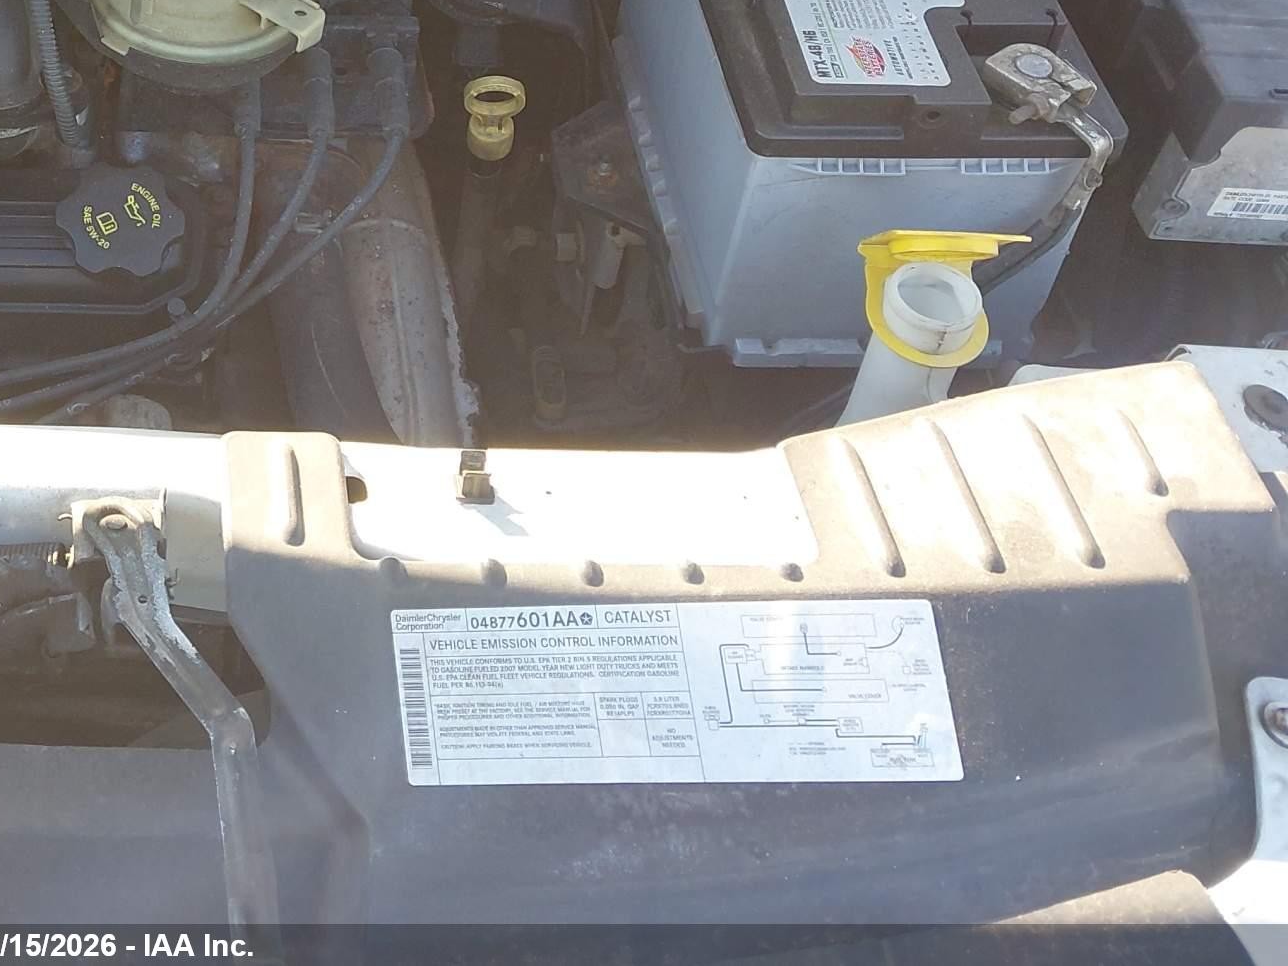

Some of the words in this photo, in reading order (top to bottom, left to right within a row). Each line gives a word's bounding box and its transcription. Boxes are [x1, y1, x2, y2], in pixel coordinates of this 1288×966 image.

[803, 30, 832, 78] MTX-48/H6
[84, 205, 92, 224] SAE
[131, 182, 160, 212] ENGINE
[152, 214, 160, 228] OIL
[86, 225, 110, 249] 5W-20
[395, 614, 461, 623] DaimlerChrysler
[471, 612, 580, 629] 04877601AA
[604, 610, 672, 624] CATALYST
[395, 622, 444, 632] Corporation
[429, 639, 478, 650] VEHICLE
[481, 638, 537, 649] EMISSION
[540, 636, 595, 648] CONTROL
[598, 635, 678, 647] INFORMATION
